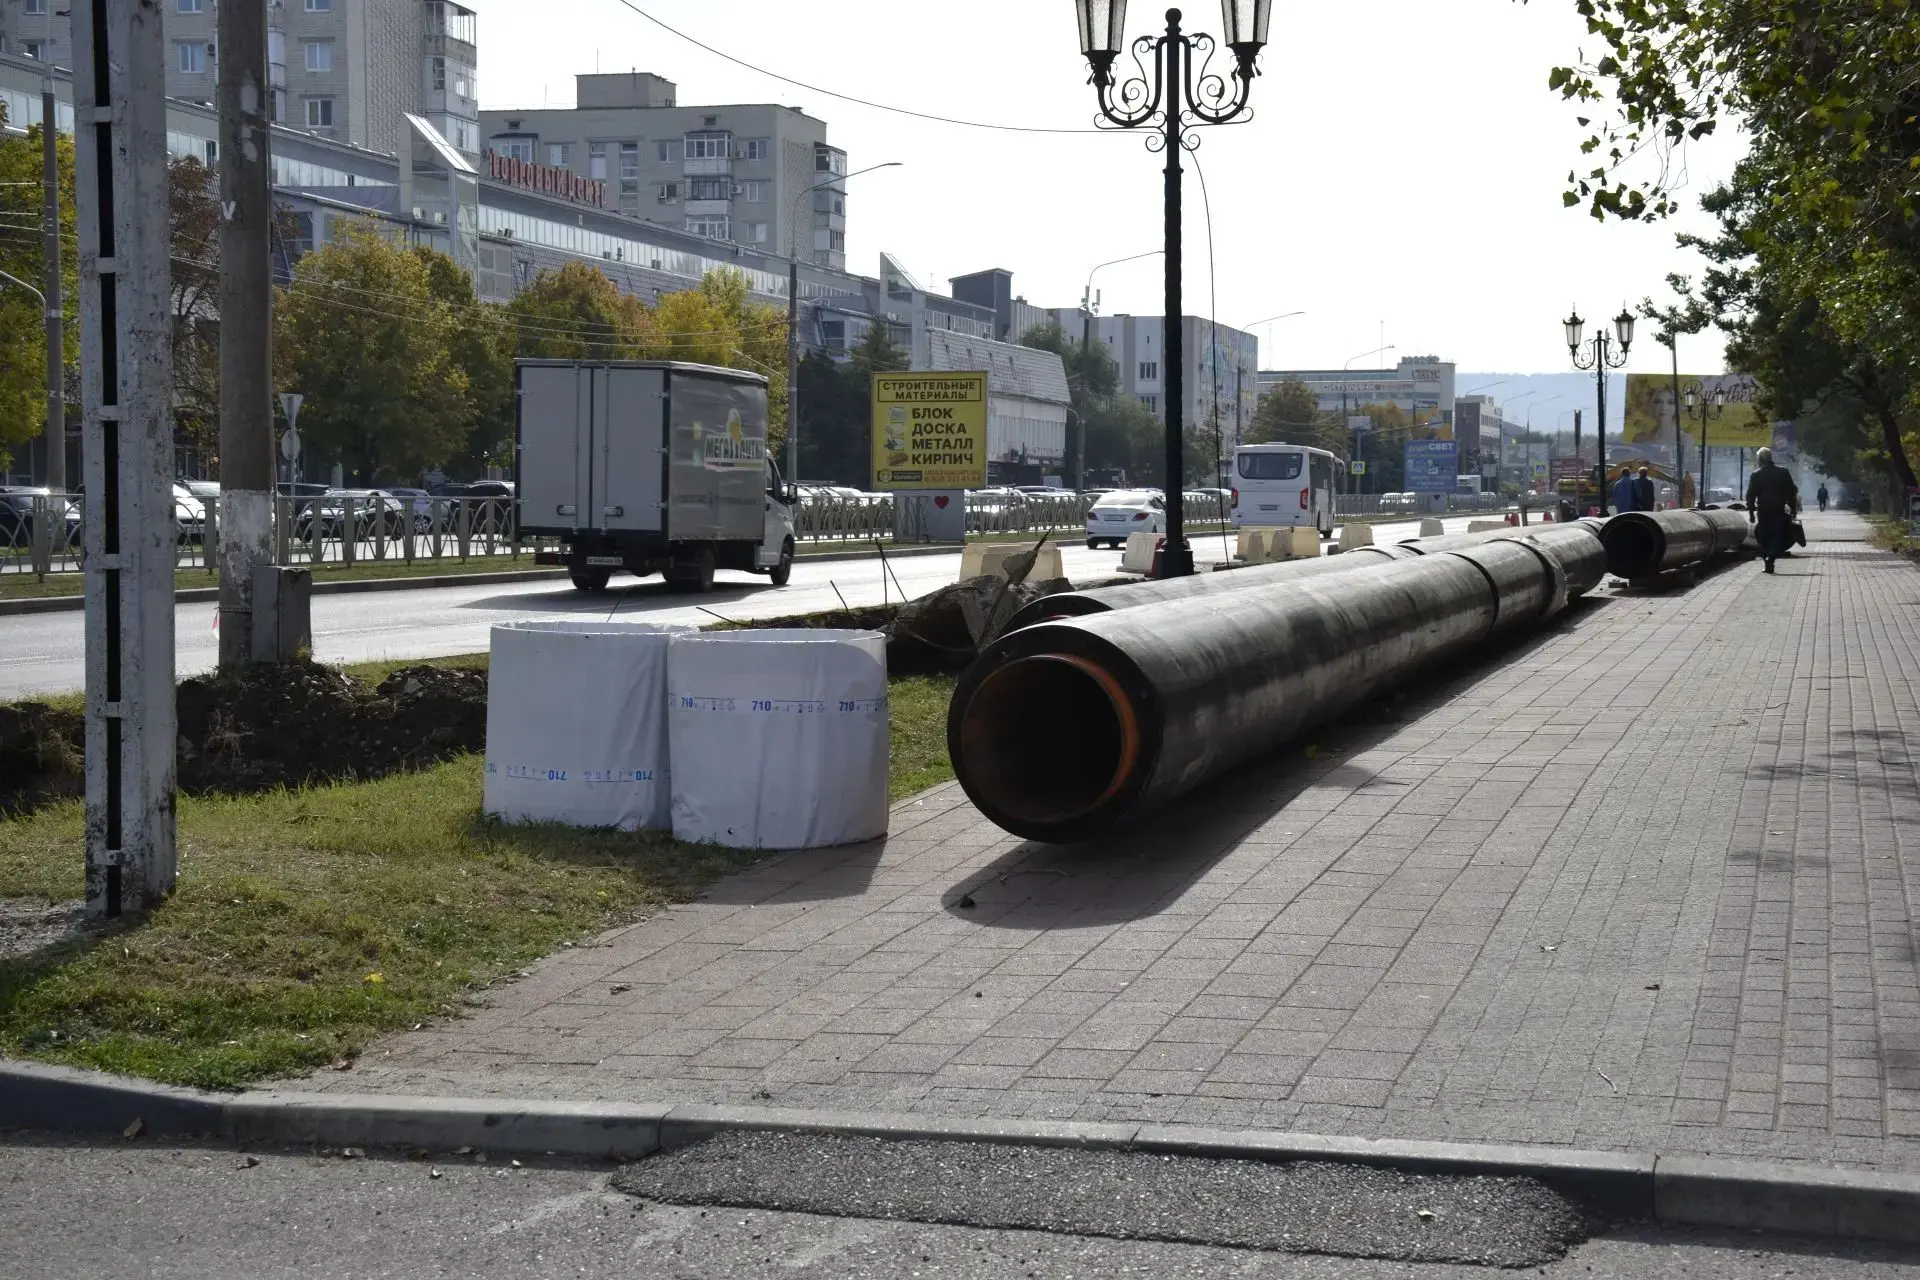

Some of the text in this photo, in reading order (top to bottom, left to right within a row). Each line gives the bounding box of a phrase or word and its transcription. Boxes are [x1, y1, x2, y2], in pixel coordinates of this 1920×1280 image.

[883, 381, 976, 391] СТРОИТЕЛЬНЫЕ
[895, 391, 968, 400] МАТЕРИАЛЫ
[912, 408, 954, 419] БЛОК
[912, 423, 967, 436] ДОСКА
[912, 438, 973, 450] МЕТАЛЛ
[912, 453, 973, 464] КИРПИЧ
[681, 697, 693, 709] 710
[752, 700, 771, 711] 710
[839, 701, 855, 712] 710
[548, 770, 566, 781] 710
[635, 770, 653, 781] 710
